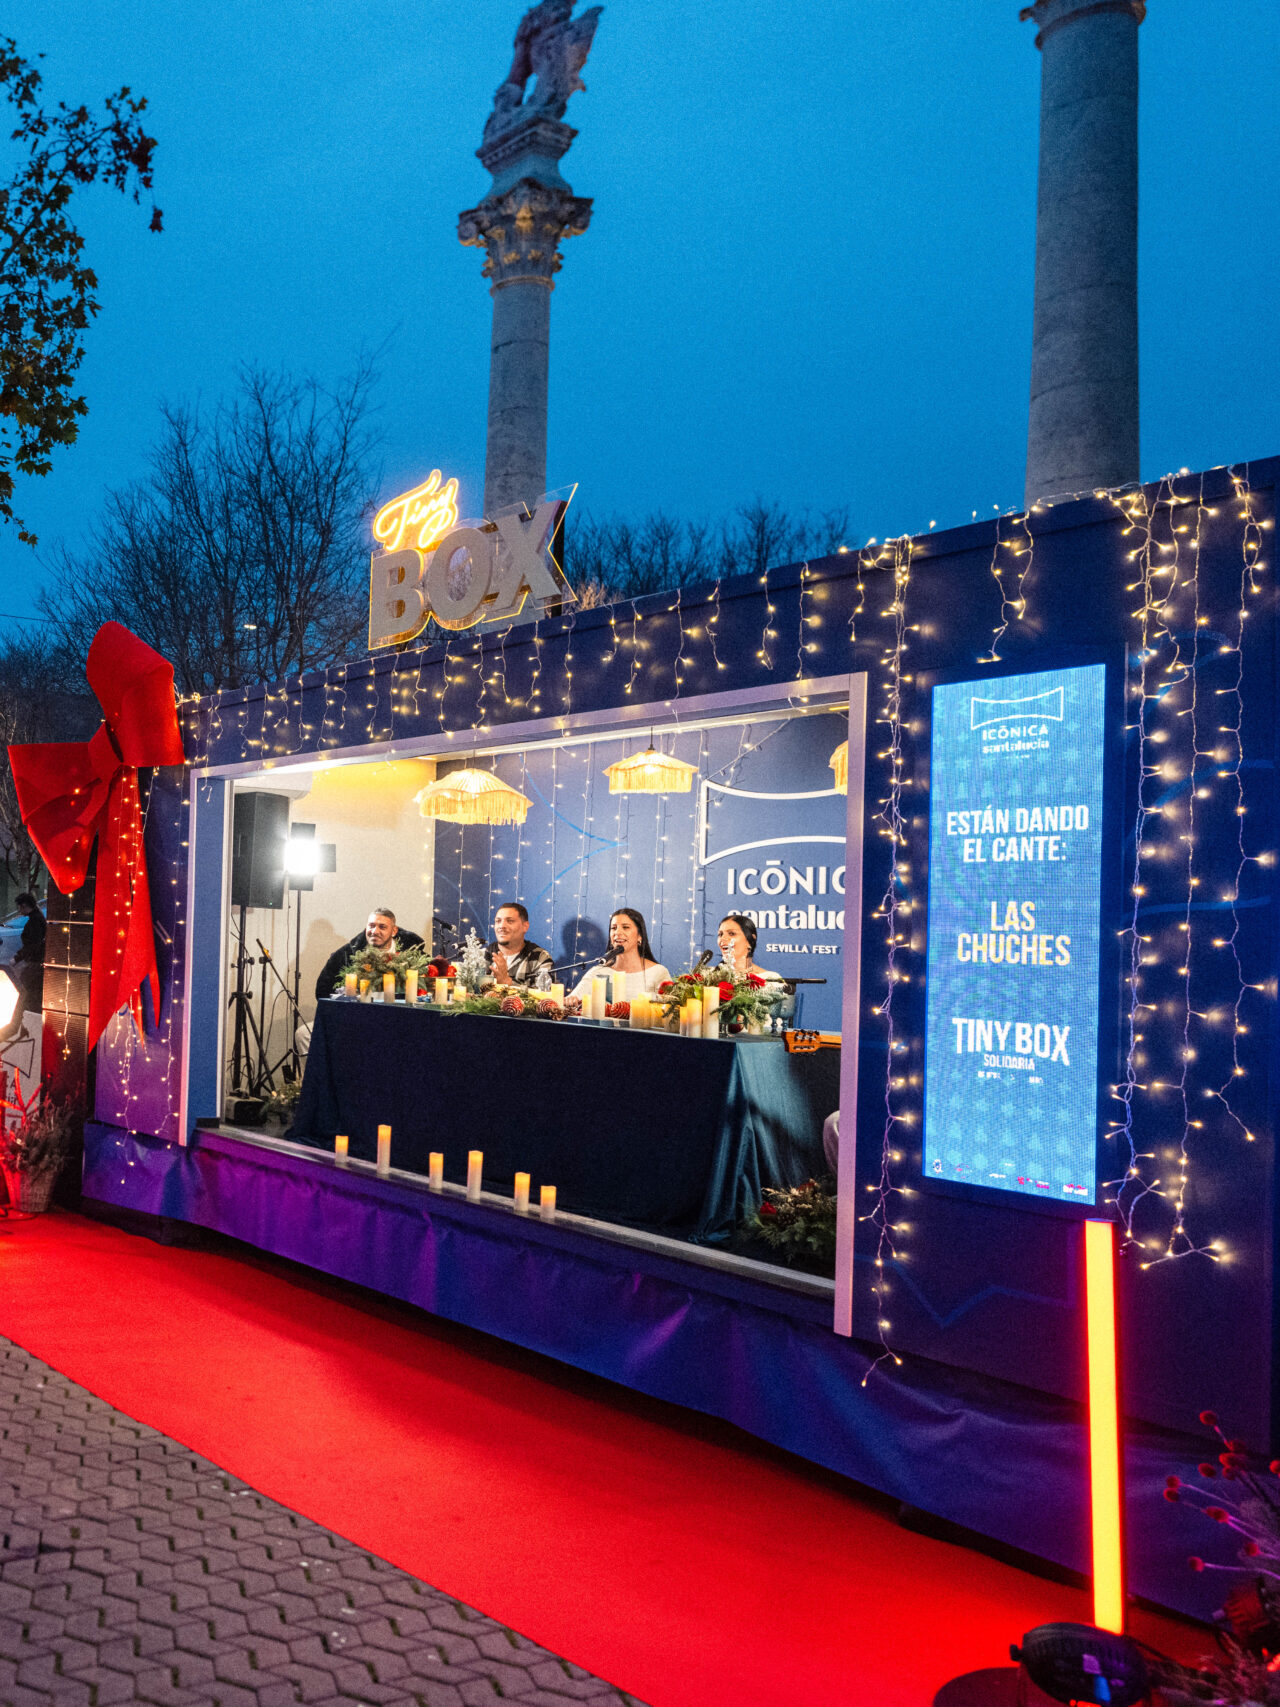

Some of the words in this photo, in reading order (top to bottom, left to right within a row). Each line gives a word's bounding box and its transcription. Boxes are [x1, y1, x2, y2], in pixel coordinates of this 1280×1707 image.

[375, 471, 458, 551] Tiny
[369, 500, 567, 648] BOX
[946, 804, 1009, 835] ESTÁN
[1015, 804, 1089, 833] DANDO
[963, 838, 986, 863] EL
[991, 835, 1067, 862] CANTE:
[727, 860, 846, 895] ICŌNIC
[991, 901, 1036, 932] LAS
[766, 943, 809, 954] SEVILLA
[812, 945, 838, 955] FEST
[957, 933, 1071, 966] CHUCHES
[952, 1018, 1012, 1054] TINY
[1015, 1022, 1070, 1066] BOX
[983, 1053, 1035, 1070] SOLIDARIA
